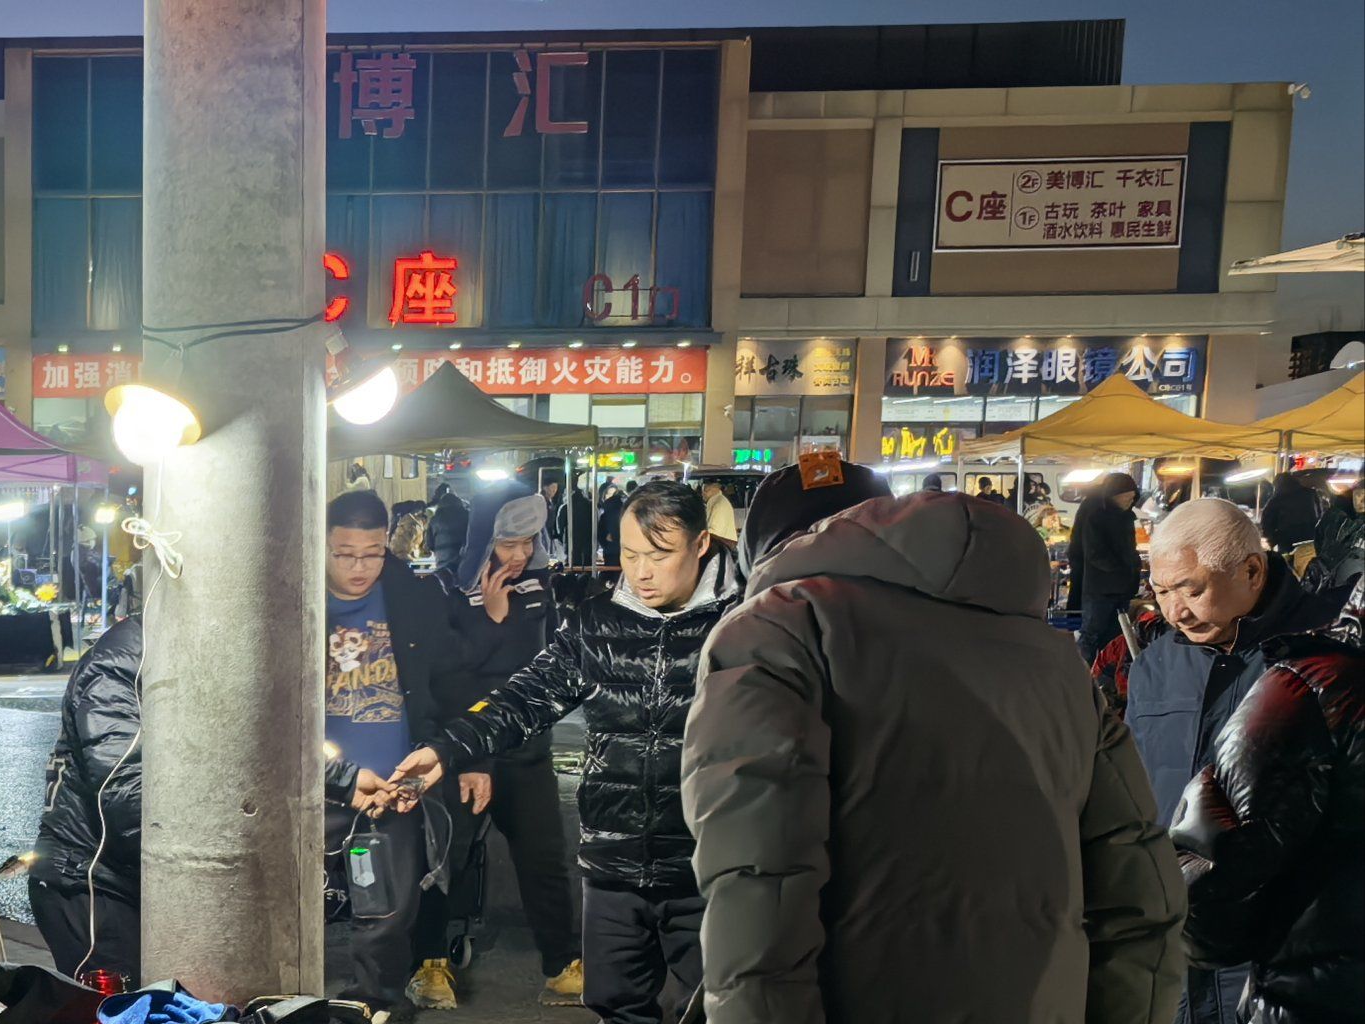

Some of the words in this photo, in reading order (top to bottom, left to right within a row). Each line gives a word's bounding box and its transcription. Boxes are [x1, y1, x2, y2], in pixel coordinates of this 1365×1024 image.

[1046, 170, 1104, 190] 美博汇
[1116, 168, 1175, 188] 千衣汇
[945, 190, 1008, 222] C座
[1044, 201, 1080, 220] 古玩
[1090, 201, 1126, 219] 茶叶
[1136, 200, 1172, 218] 家具
[1042, 223, 1103, 240] 酒水饮料
[1110, 220, 1172, 239] 惠民生鲜
[42, 361, 144, 388] 加强消
[965, 346, 1198, 384] 润泽眼镜公司
